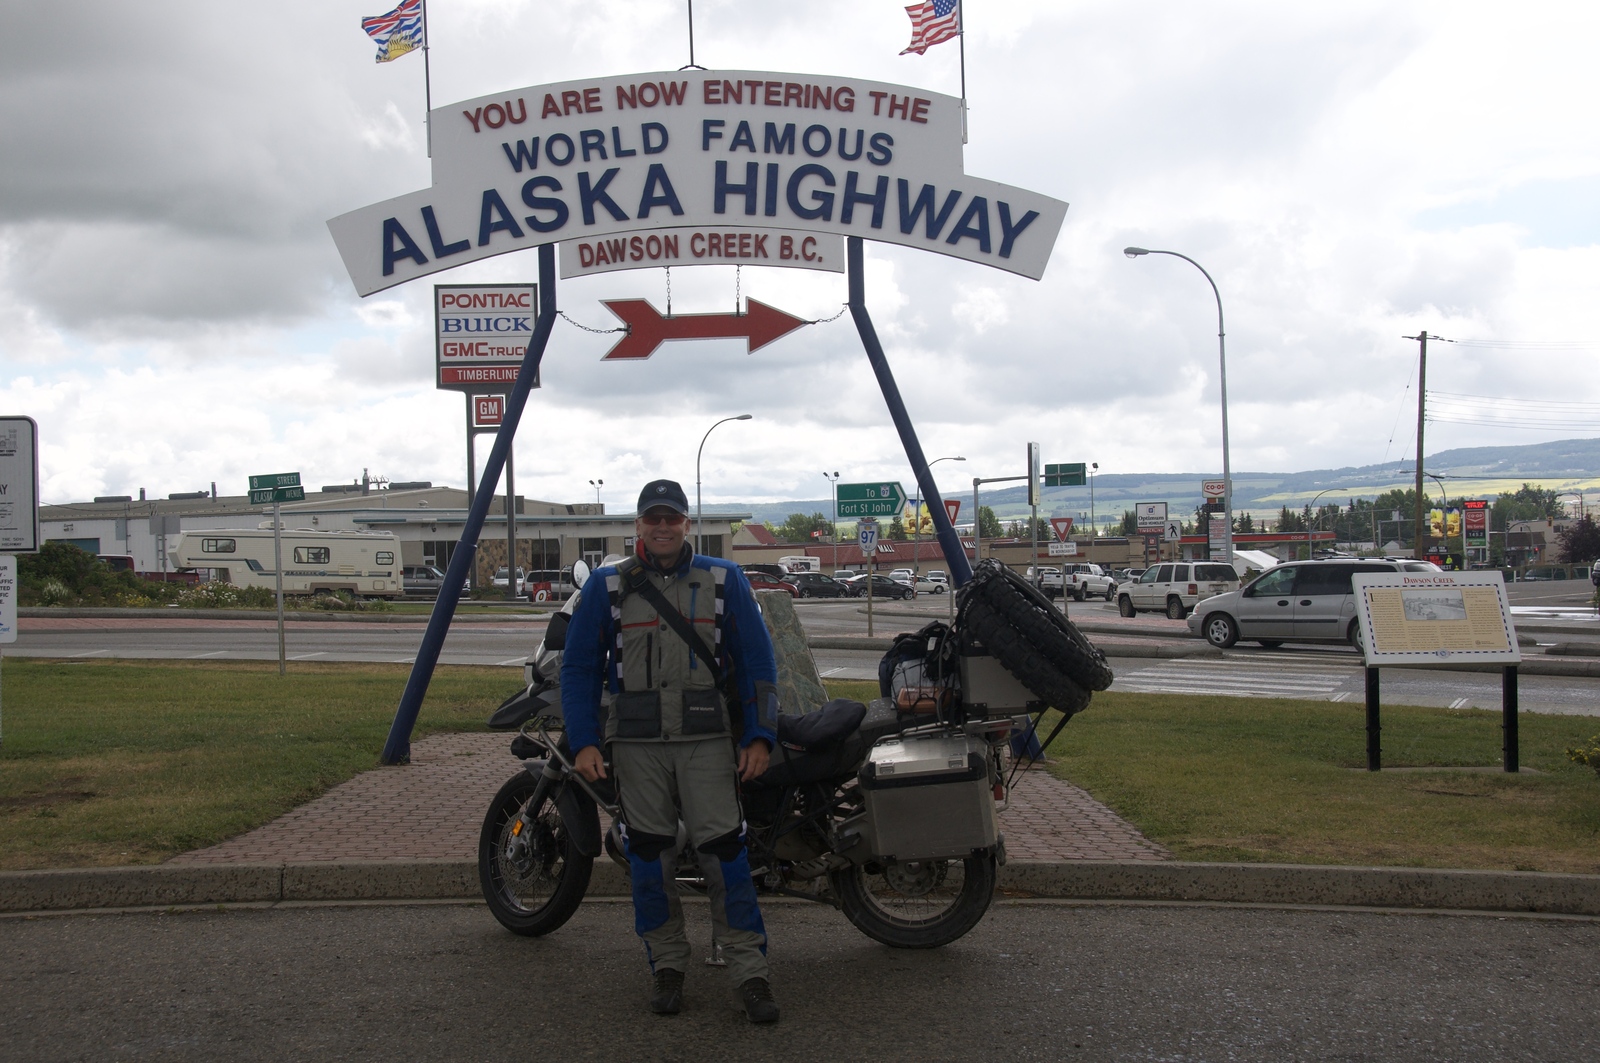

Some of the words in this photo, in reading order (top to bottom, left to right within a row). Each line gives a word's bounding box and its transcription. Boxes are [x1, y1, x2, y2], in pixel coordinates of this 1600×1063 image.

[462, 98, 527, 133] YOU
[541, 87, 603, 119] ARE
[616, 81, 688, 110] NOW
[703, 79, 856, 113] ENTERING
[869, 91, 931, 124] THE
[501, 121, 669, 173] WORLD
[702, 119, 895, 166] FAMOUS
[382, 162, 684, 276] ALASKA
[713, 160, 1040, 258] HIGHWAY
[578, 235, 680, 268] DAWSON
[690, 232, 768, 260] CREEK
[779, 235, 824, 263] B.C.
[441, 293, 531, 308] PONTIAC
[441, 317, 532, 333] BUICK
[443, 342, 488, 357] GMC
[457, 368, 519, 380] TIMBERLINE
[480, 401, 498, 415] GM
[253, 477, 259, 488] 8
[276, 475, 297, 485] STREET
[253, 491, 273, 502] ALASKA
[285, 488, 302, 498] AVENUE
[865, 488, 876, 498] To
[840, 504, 857, 514] Fort
[860, 503, 868, 513] St
[871, 502, 892, 513] John
[860, 530, 876, 544] 97
[877, 544, 895, 553] MALL
